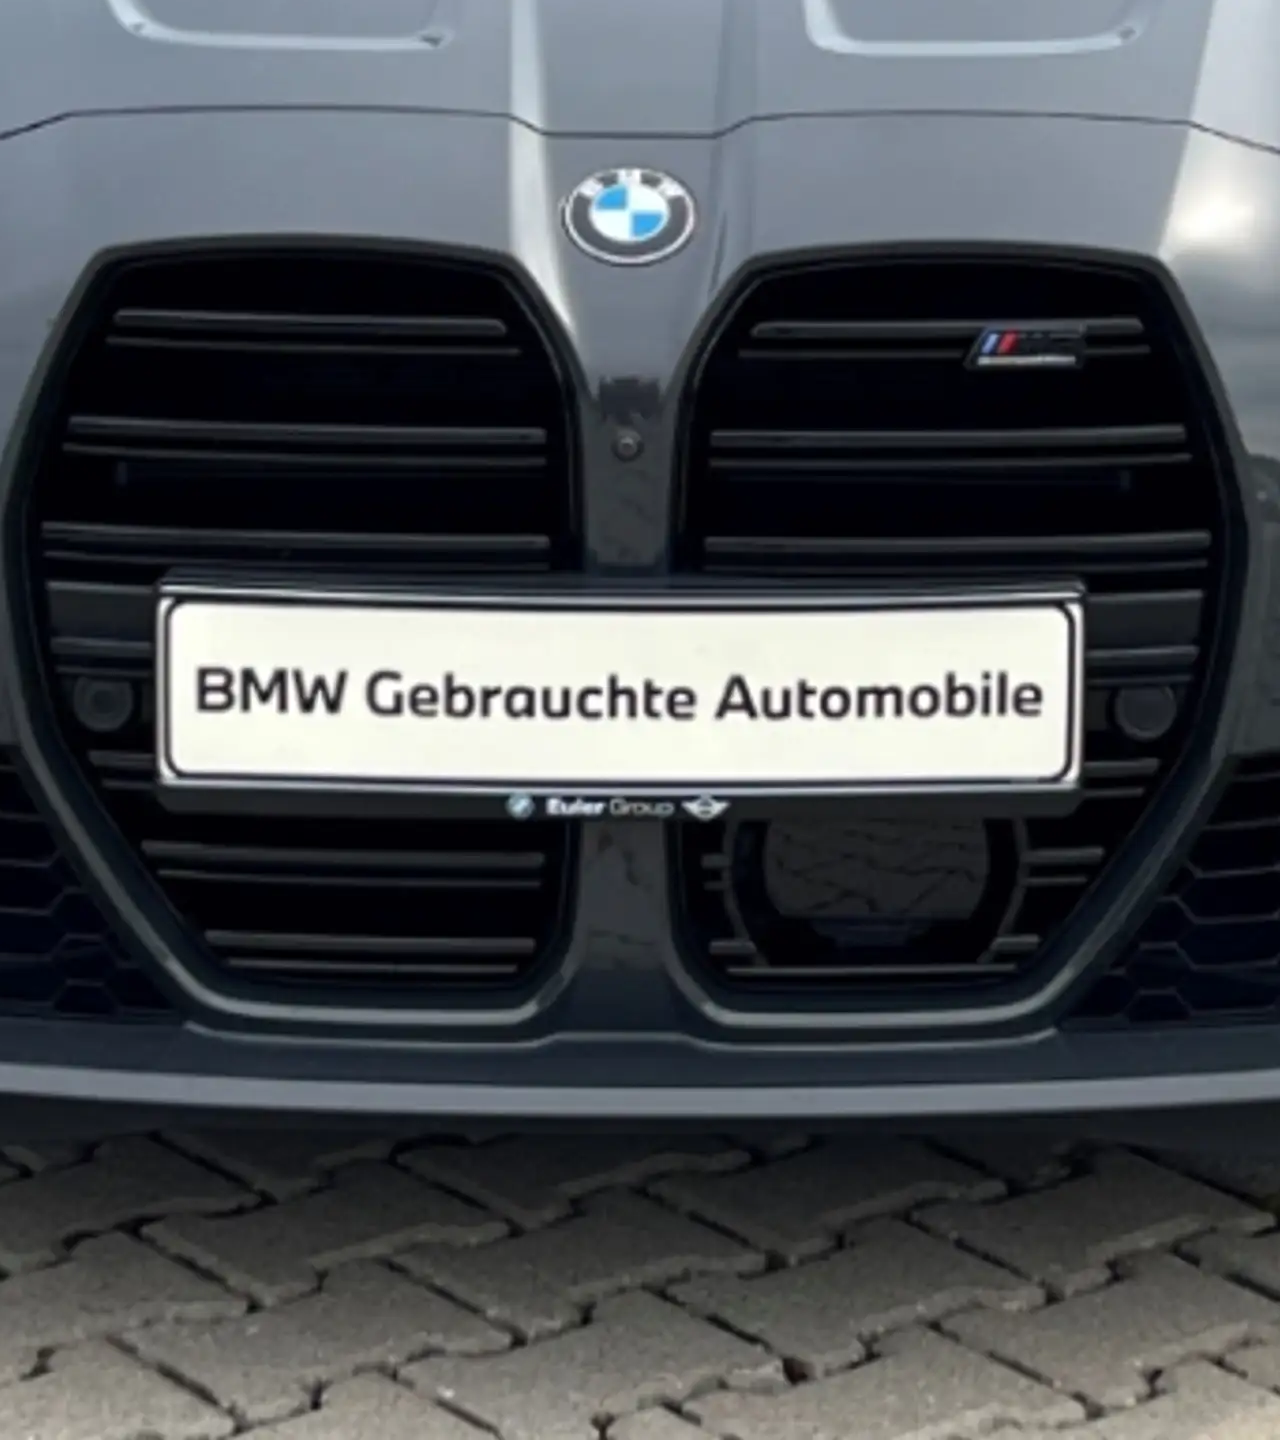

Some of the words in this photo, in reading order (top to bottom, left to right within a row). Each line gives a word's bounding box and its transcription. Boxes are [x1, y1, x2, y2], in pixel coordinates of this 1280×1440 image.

[196, 666, 348, 715] BMW
[365, 670, 698, 720] Gebrauchte
[714, 671, 1044, 720] Automobile
[547, 798, 605, 816] Euler
[609, 798, 675, 818] Group
